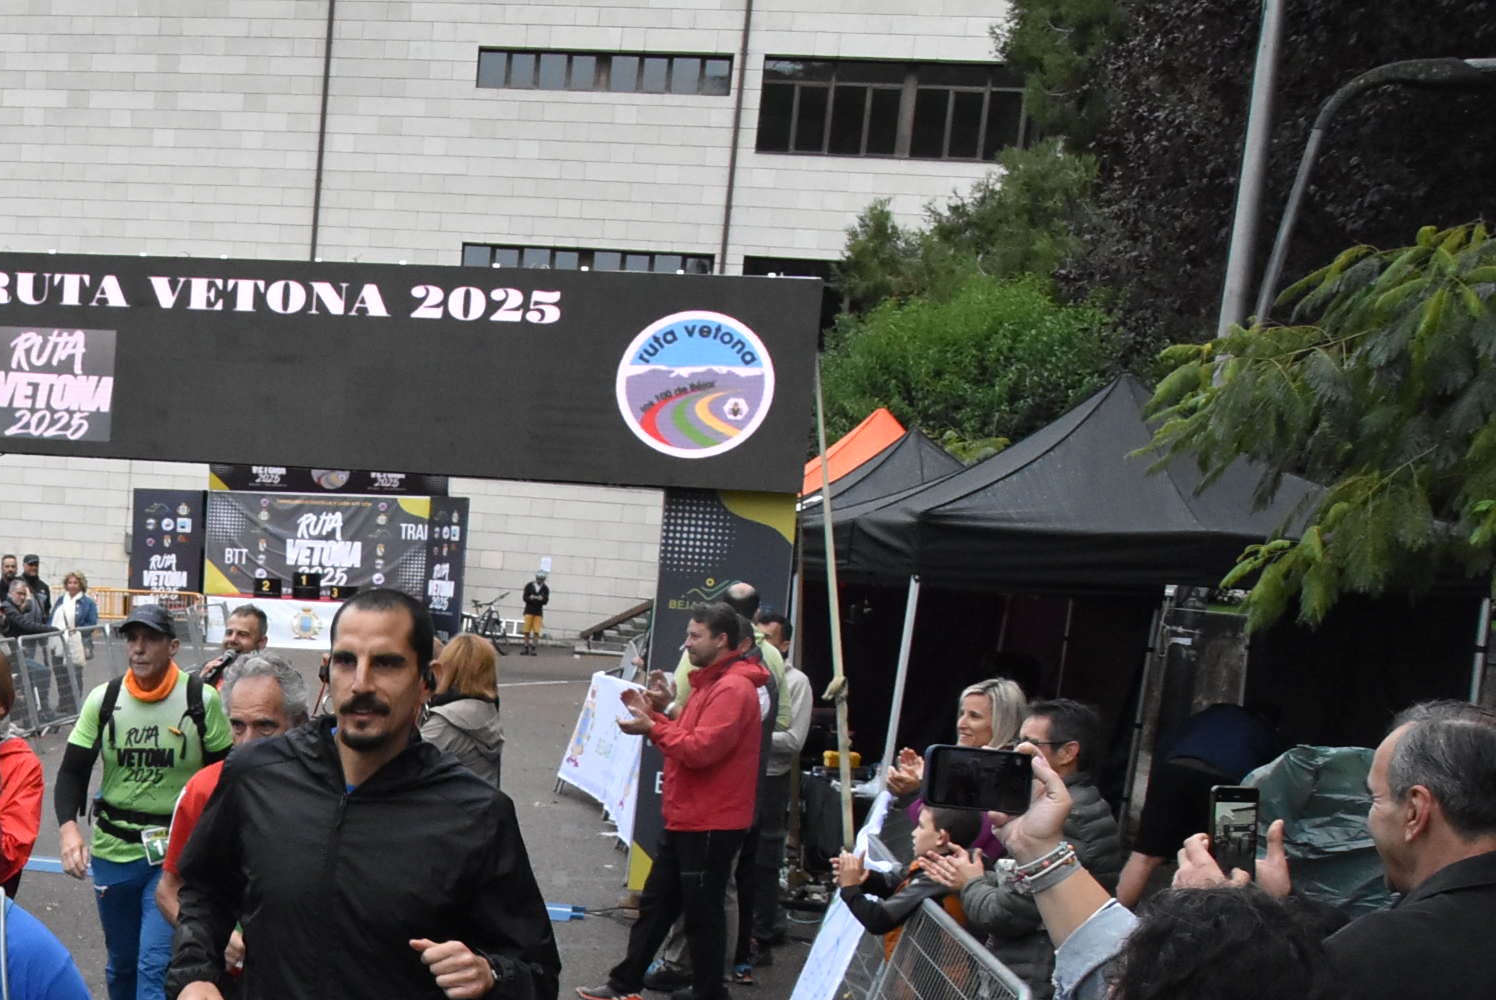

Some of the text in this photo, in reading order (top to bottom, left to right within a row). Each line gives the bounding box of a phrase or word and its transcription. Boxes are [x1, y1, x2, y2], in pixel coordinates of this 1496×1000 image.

[147, 276, 392, 317] VETONA
[410, 284, 562, 324] 2025
[9, 329, 86, 375] RUTA
[638, 323, 758, 366] ruta vetona
[4, 409, 90, 440] 2025
[297, 511, 343, 540] RUTA
[400, 523, 428, 541] TRAI
[149, 553, 177, 571] RUTA
[224, 548, 248, 565] BTT
[286, 539, 362, 568] VETONA
[143, 570, 188, 588] VETONA
[261, 580, 271, 592] 2
[301, 575, 308, 586] 1
[331, 588, 339, 598] 3
[125, 725, 159, 748] RUTA
[117, 748, 174, 768] VETONA
[124, 767, 164, 785] 2025
